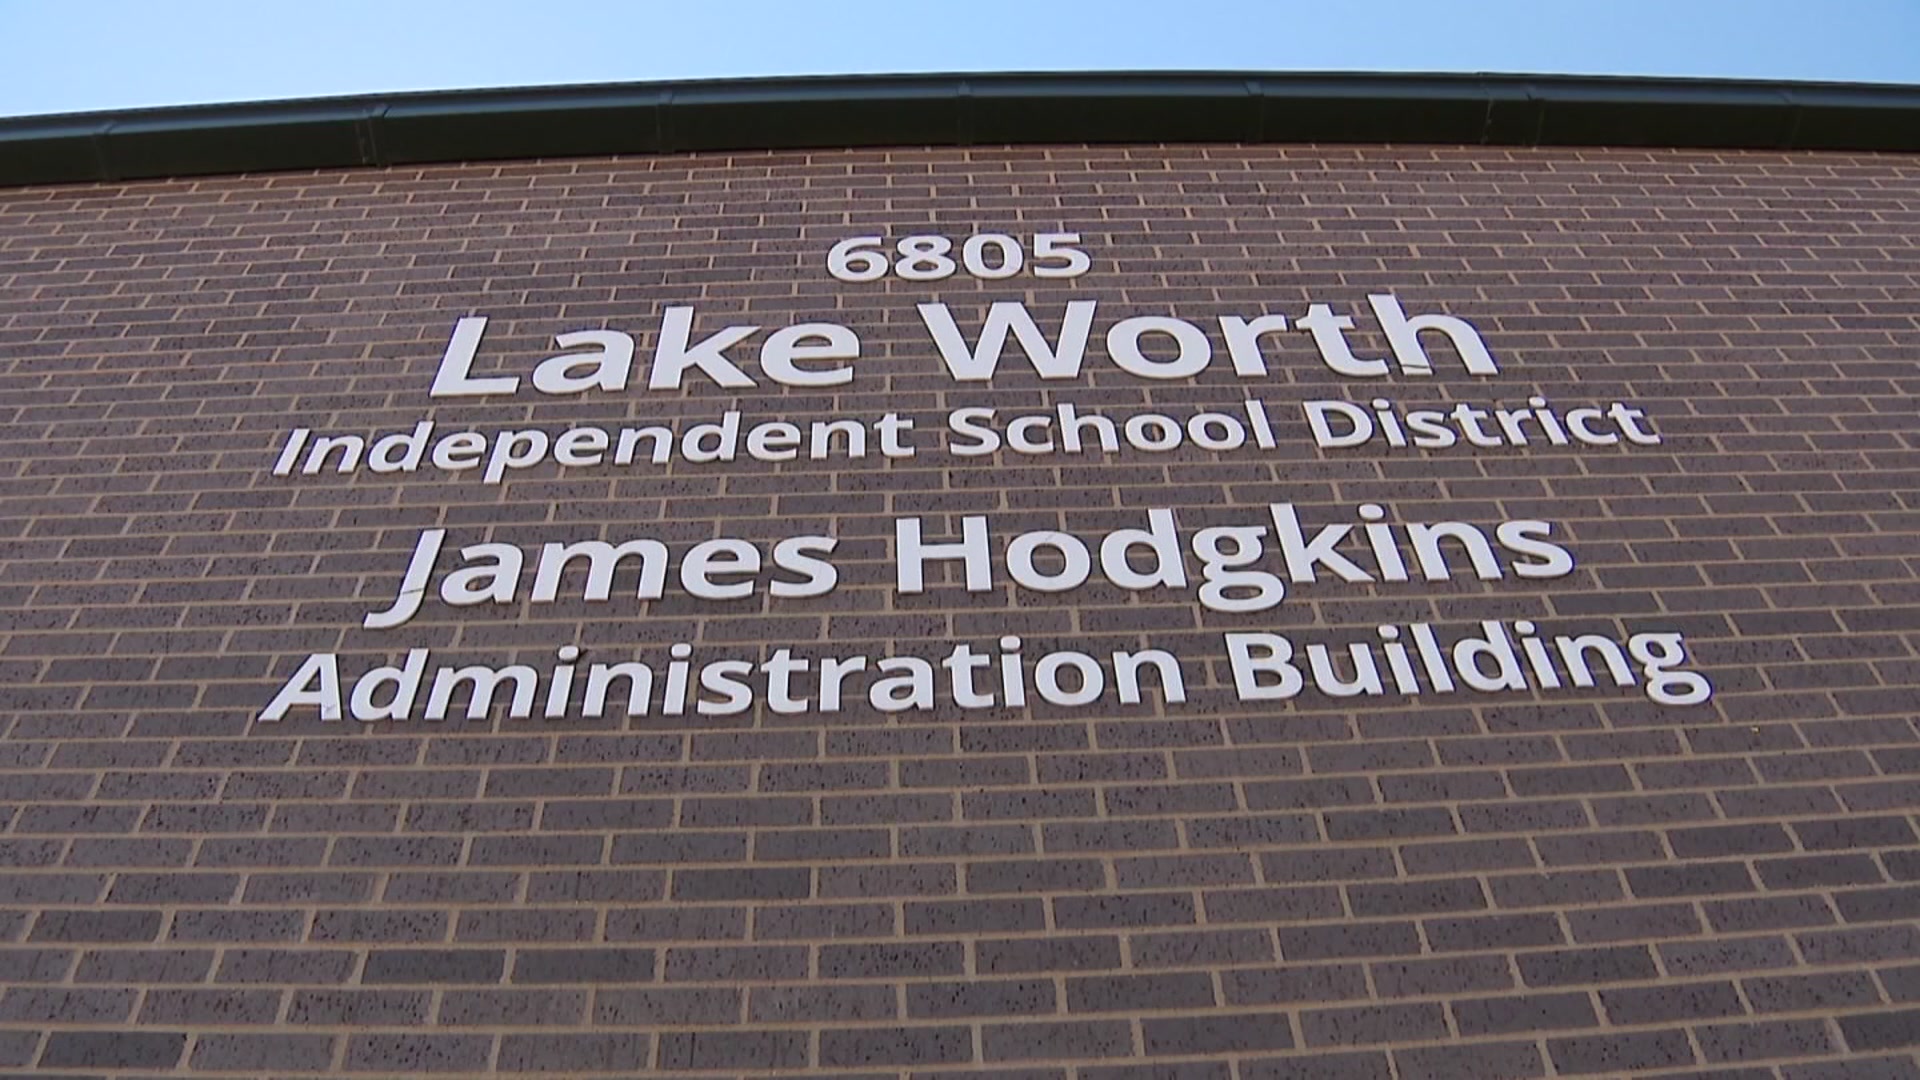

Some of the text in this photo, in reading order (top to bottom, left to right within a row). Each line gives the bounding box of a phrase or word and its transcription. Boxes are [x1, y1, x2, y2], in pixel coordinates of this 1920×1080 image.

[828, 231, 1091, 282] 6805
[430, 293, 1498, 397] Lake Worth
[273, 396, 1661, 485] Independent School District
[364, 502, 1573, 629] James Hodgkins
[258, 619, 1711, 721] Administration Building
